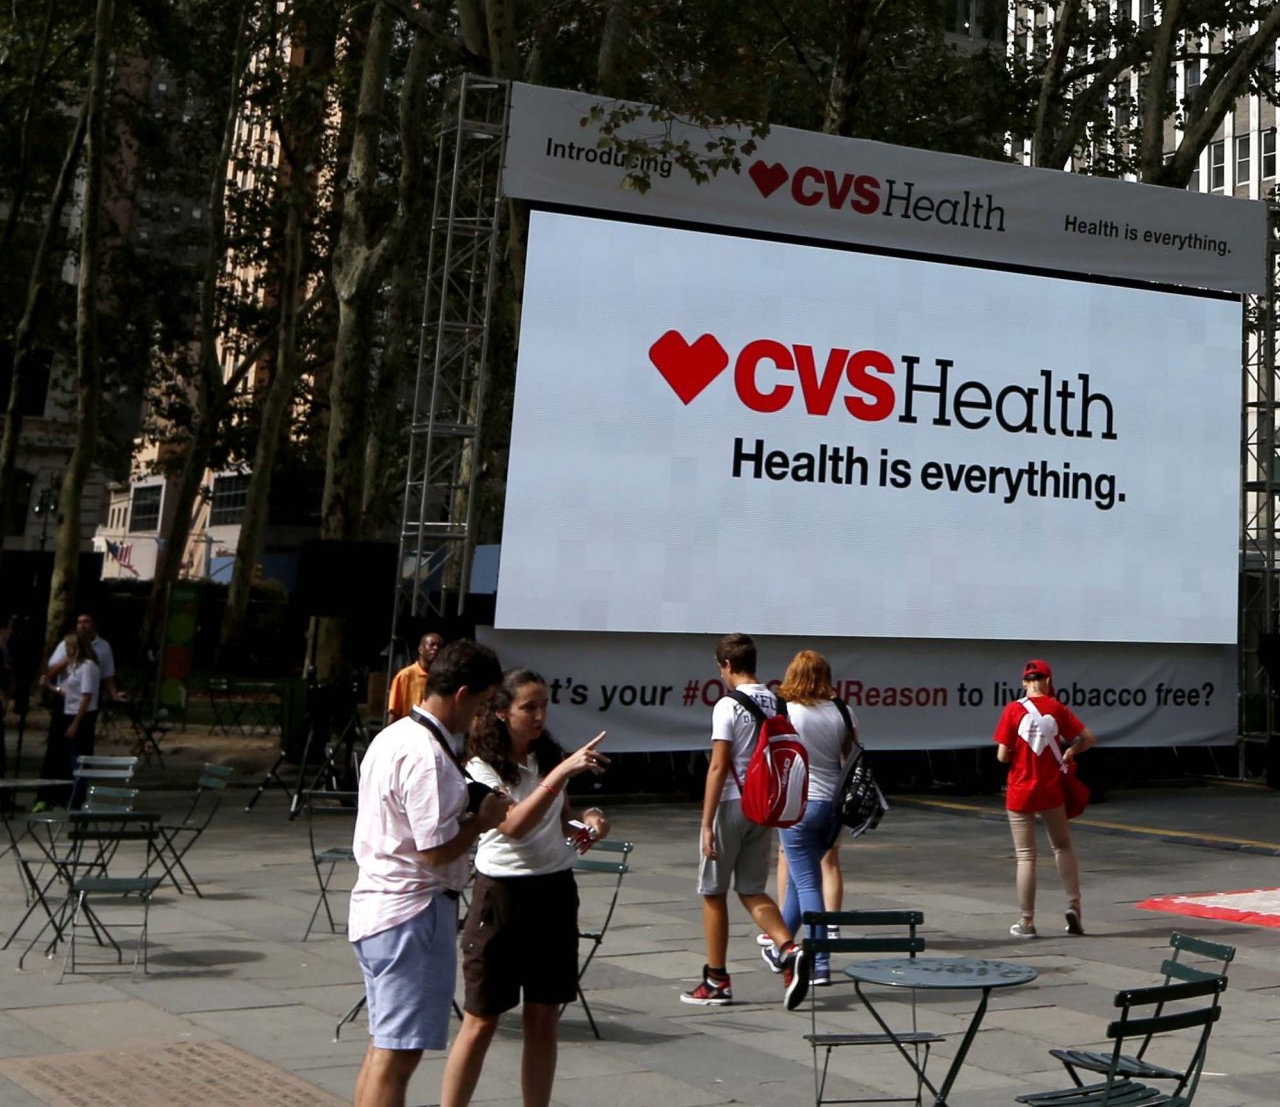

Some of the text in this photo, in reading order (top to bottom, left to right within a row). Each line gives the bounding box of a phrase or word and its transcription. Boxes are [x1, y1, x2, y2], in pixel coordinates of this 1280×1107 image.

[1063, 215, 1232, 257] Health is everything.
[732, 437, 1127, 510] Health is everything.
[550, 677, 589, 705] t's
[597, 684, 673, 712] your
[957, 682, 984, 707] to
[993, 681, 1028, 707] liv
[1055, 682, 1147, 708] obacco
[1155, 681, 1215, 708] free?
